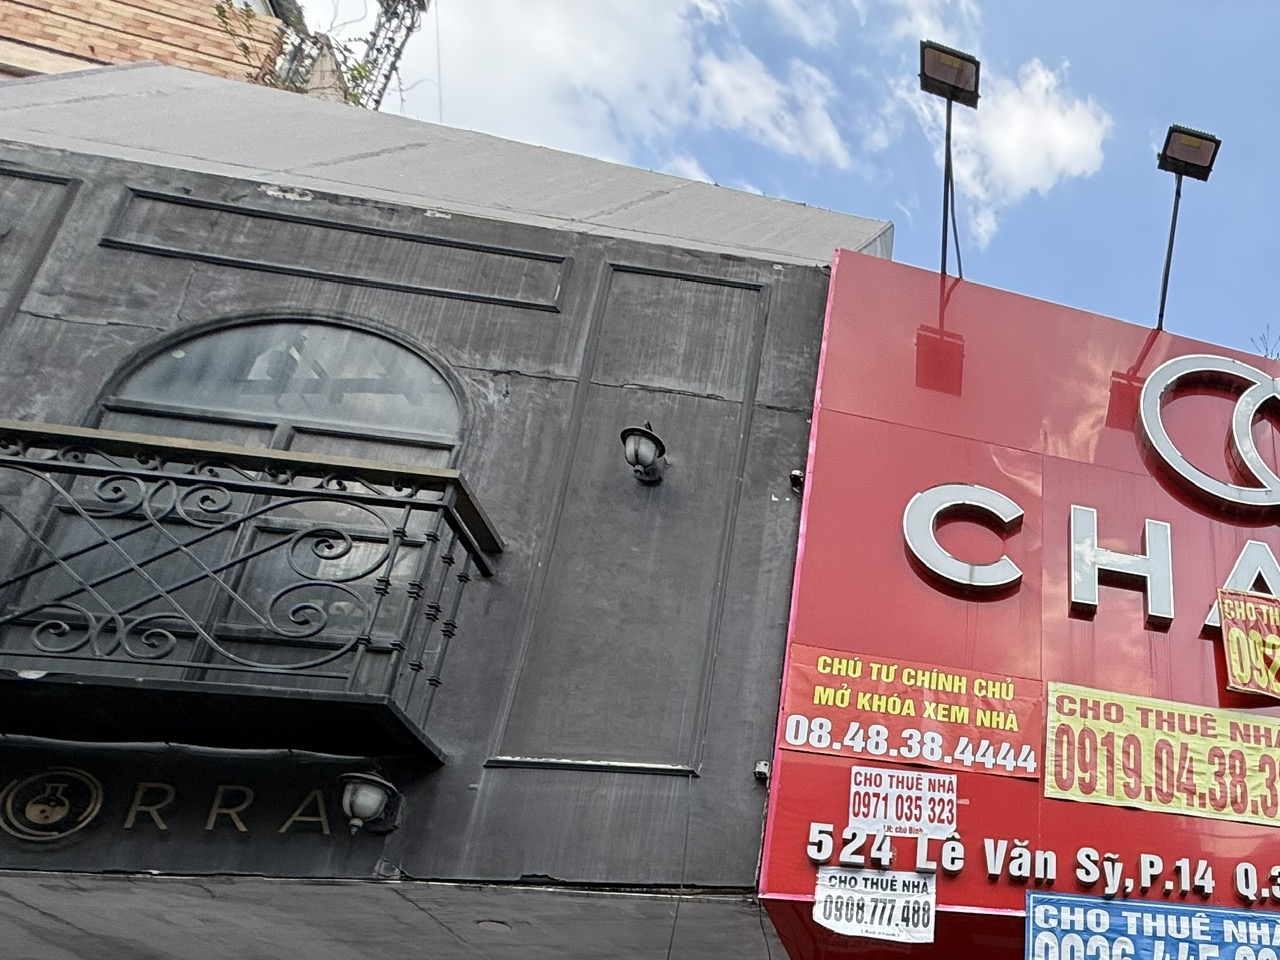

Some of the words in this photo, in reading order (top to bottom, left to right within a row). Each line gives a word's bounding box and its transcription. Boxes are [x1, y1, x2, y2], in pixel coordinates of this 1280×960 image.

[1224, 599, 1256, 621] CHO
[817, 656, 861, 677] CHÚ
[870, 663, 898, 683] TƯ
[902, 668, 966, 694] CHÍNH
[974, 678, 1014, 700] CHỦ
[813, 684, 851, 707] MỞ
[858, 693, 916, 717] KHÓA
[923, 701, 969, 724] XEM
[977, 710, 1018, 731] NHÀ
[1056, 695, 1124, 723] CHO
[1136, 707, 1217, 738] THUÊ
[785, 715, 1036, 772] 08.48.38.4444
[854, 772, 882, 787] CHO
[888, 774, 922, 791] THUÊ
[928, 777, 954, 793] NHÀ
[852, 791, 888, 819] 0971
[896, 794, 922, 822] 035
[928, 797, 954, 825] 323
[807, 822, 893, 866] 524
[916, 832, 964, 873] Lê
[984, 839, 1056, 881] Văn
[829, 875, 857, 888] CHO
[863, 876, 897, 892] THUÊ
[902, 878, 929, 894] NHÀ
[1035, 905, 1110, 933] CHO
[1122, 912, 1211, 940] THUÊ
